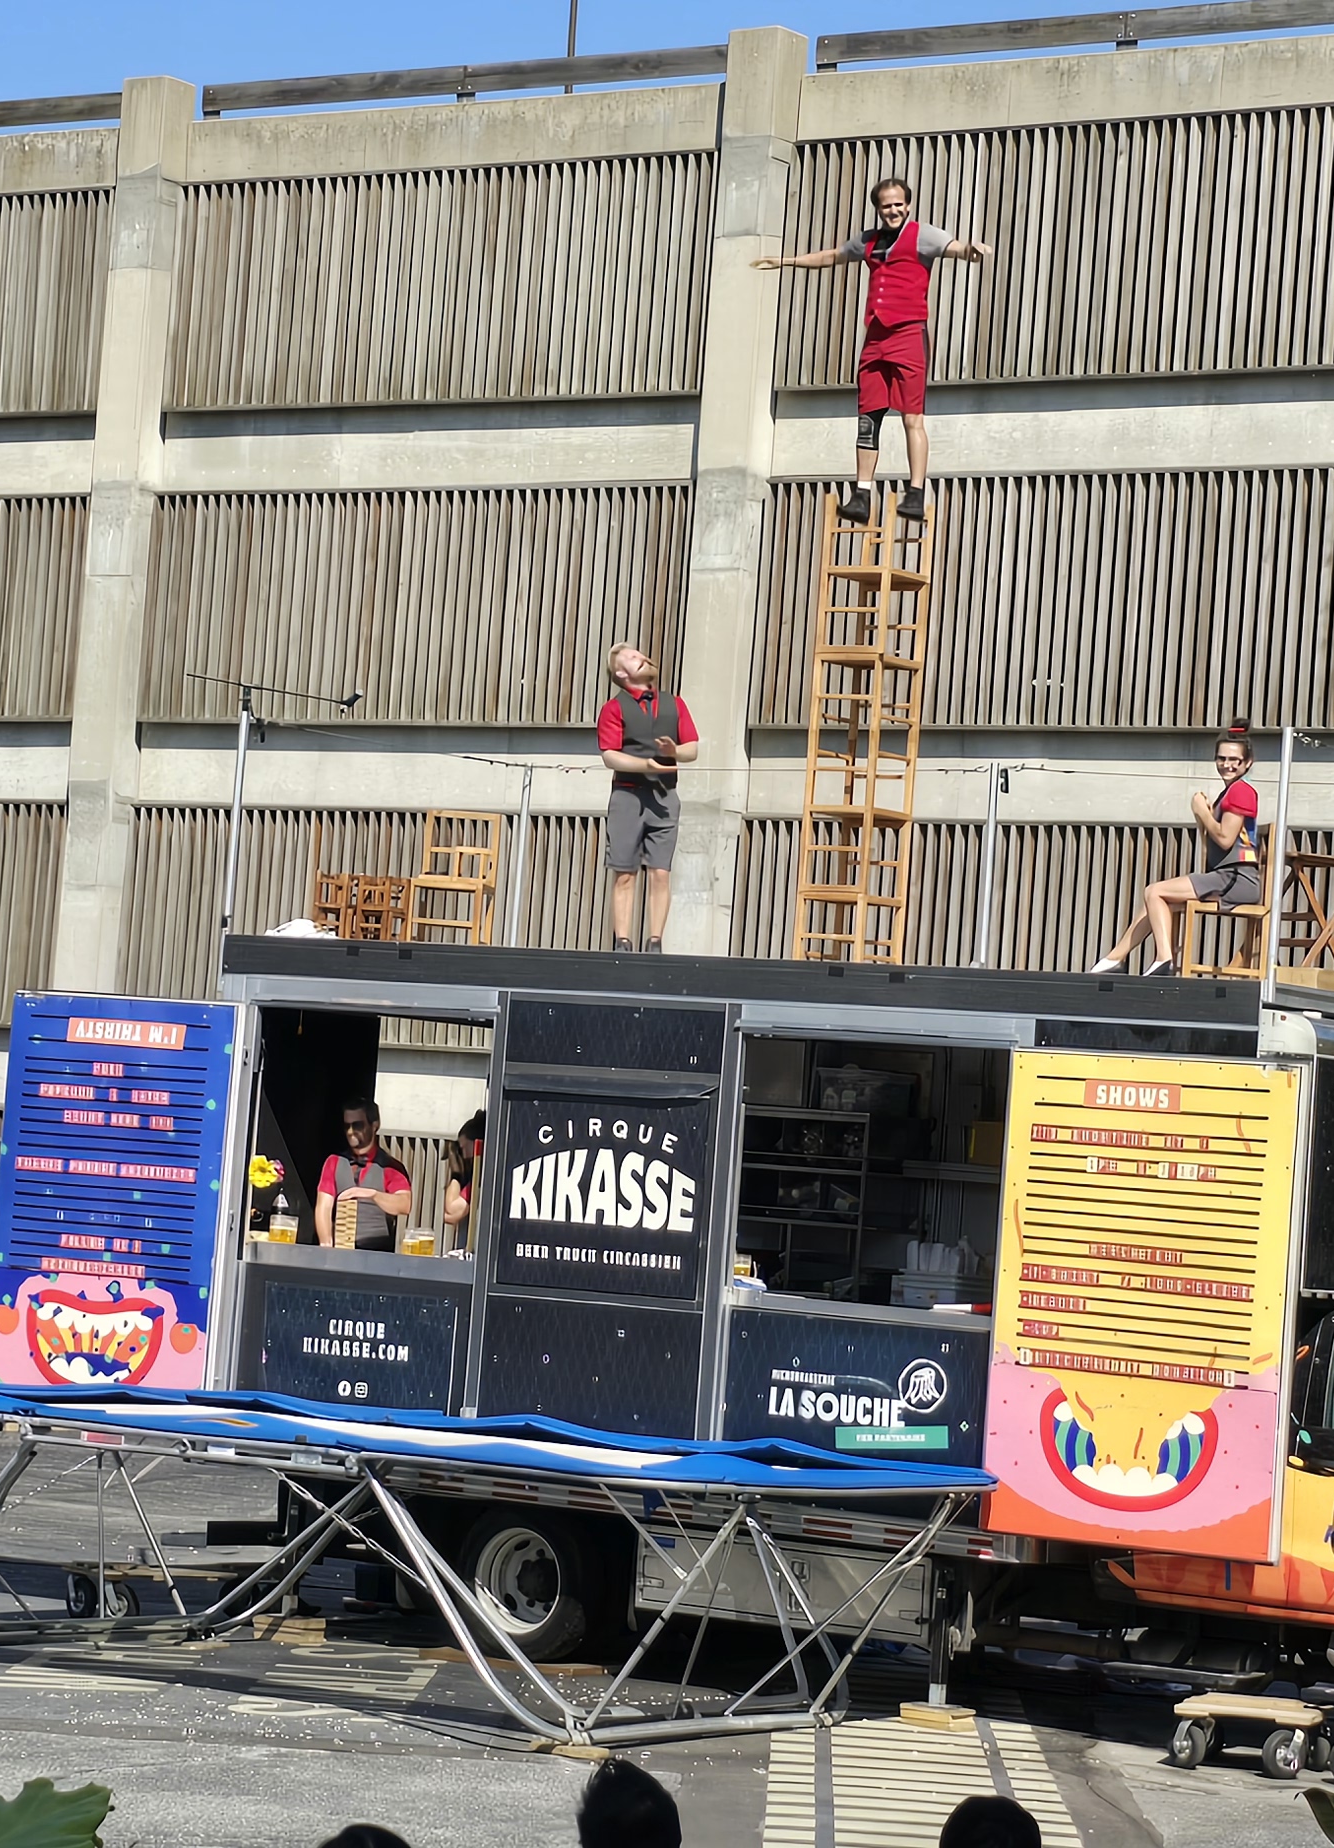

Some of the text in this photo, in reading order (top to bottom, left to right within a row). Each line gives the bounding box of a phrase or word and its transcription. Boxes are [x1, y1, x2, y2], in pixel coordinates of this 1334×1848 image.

[74, 1019, 178, 1046] I'M THIRSTY
[1095, 1083, 1170, 1110] SHOWS
[537, 1117, 679, 1154] CIRQUE
[508, 1147, 697, 1233] KIKASSE
[515, 1242, 550, 1260] BEER
[554, 1245, 598, 1264] TRUCK
[328, 1318, 386, 1341] CIRQUE
[302, 1336, 410, 1362] KIKASSE.COM
[768, 1386, 906, 1428] LA SOUCHE
